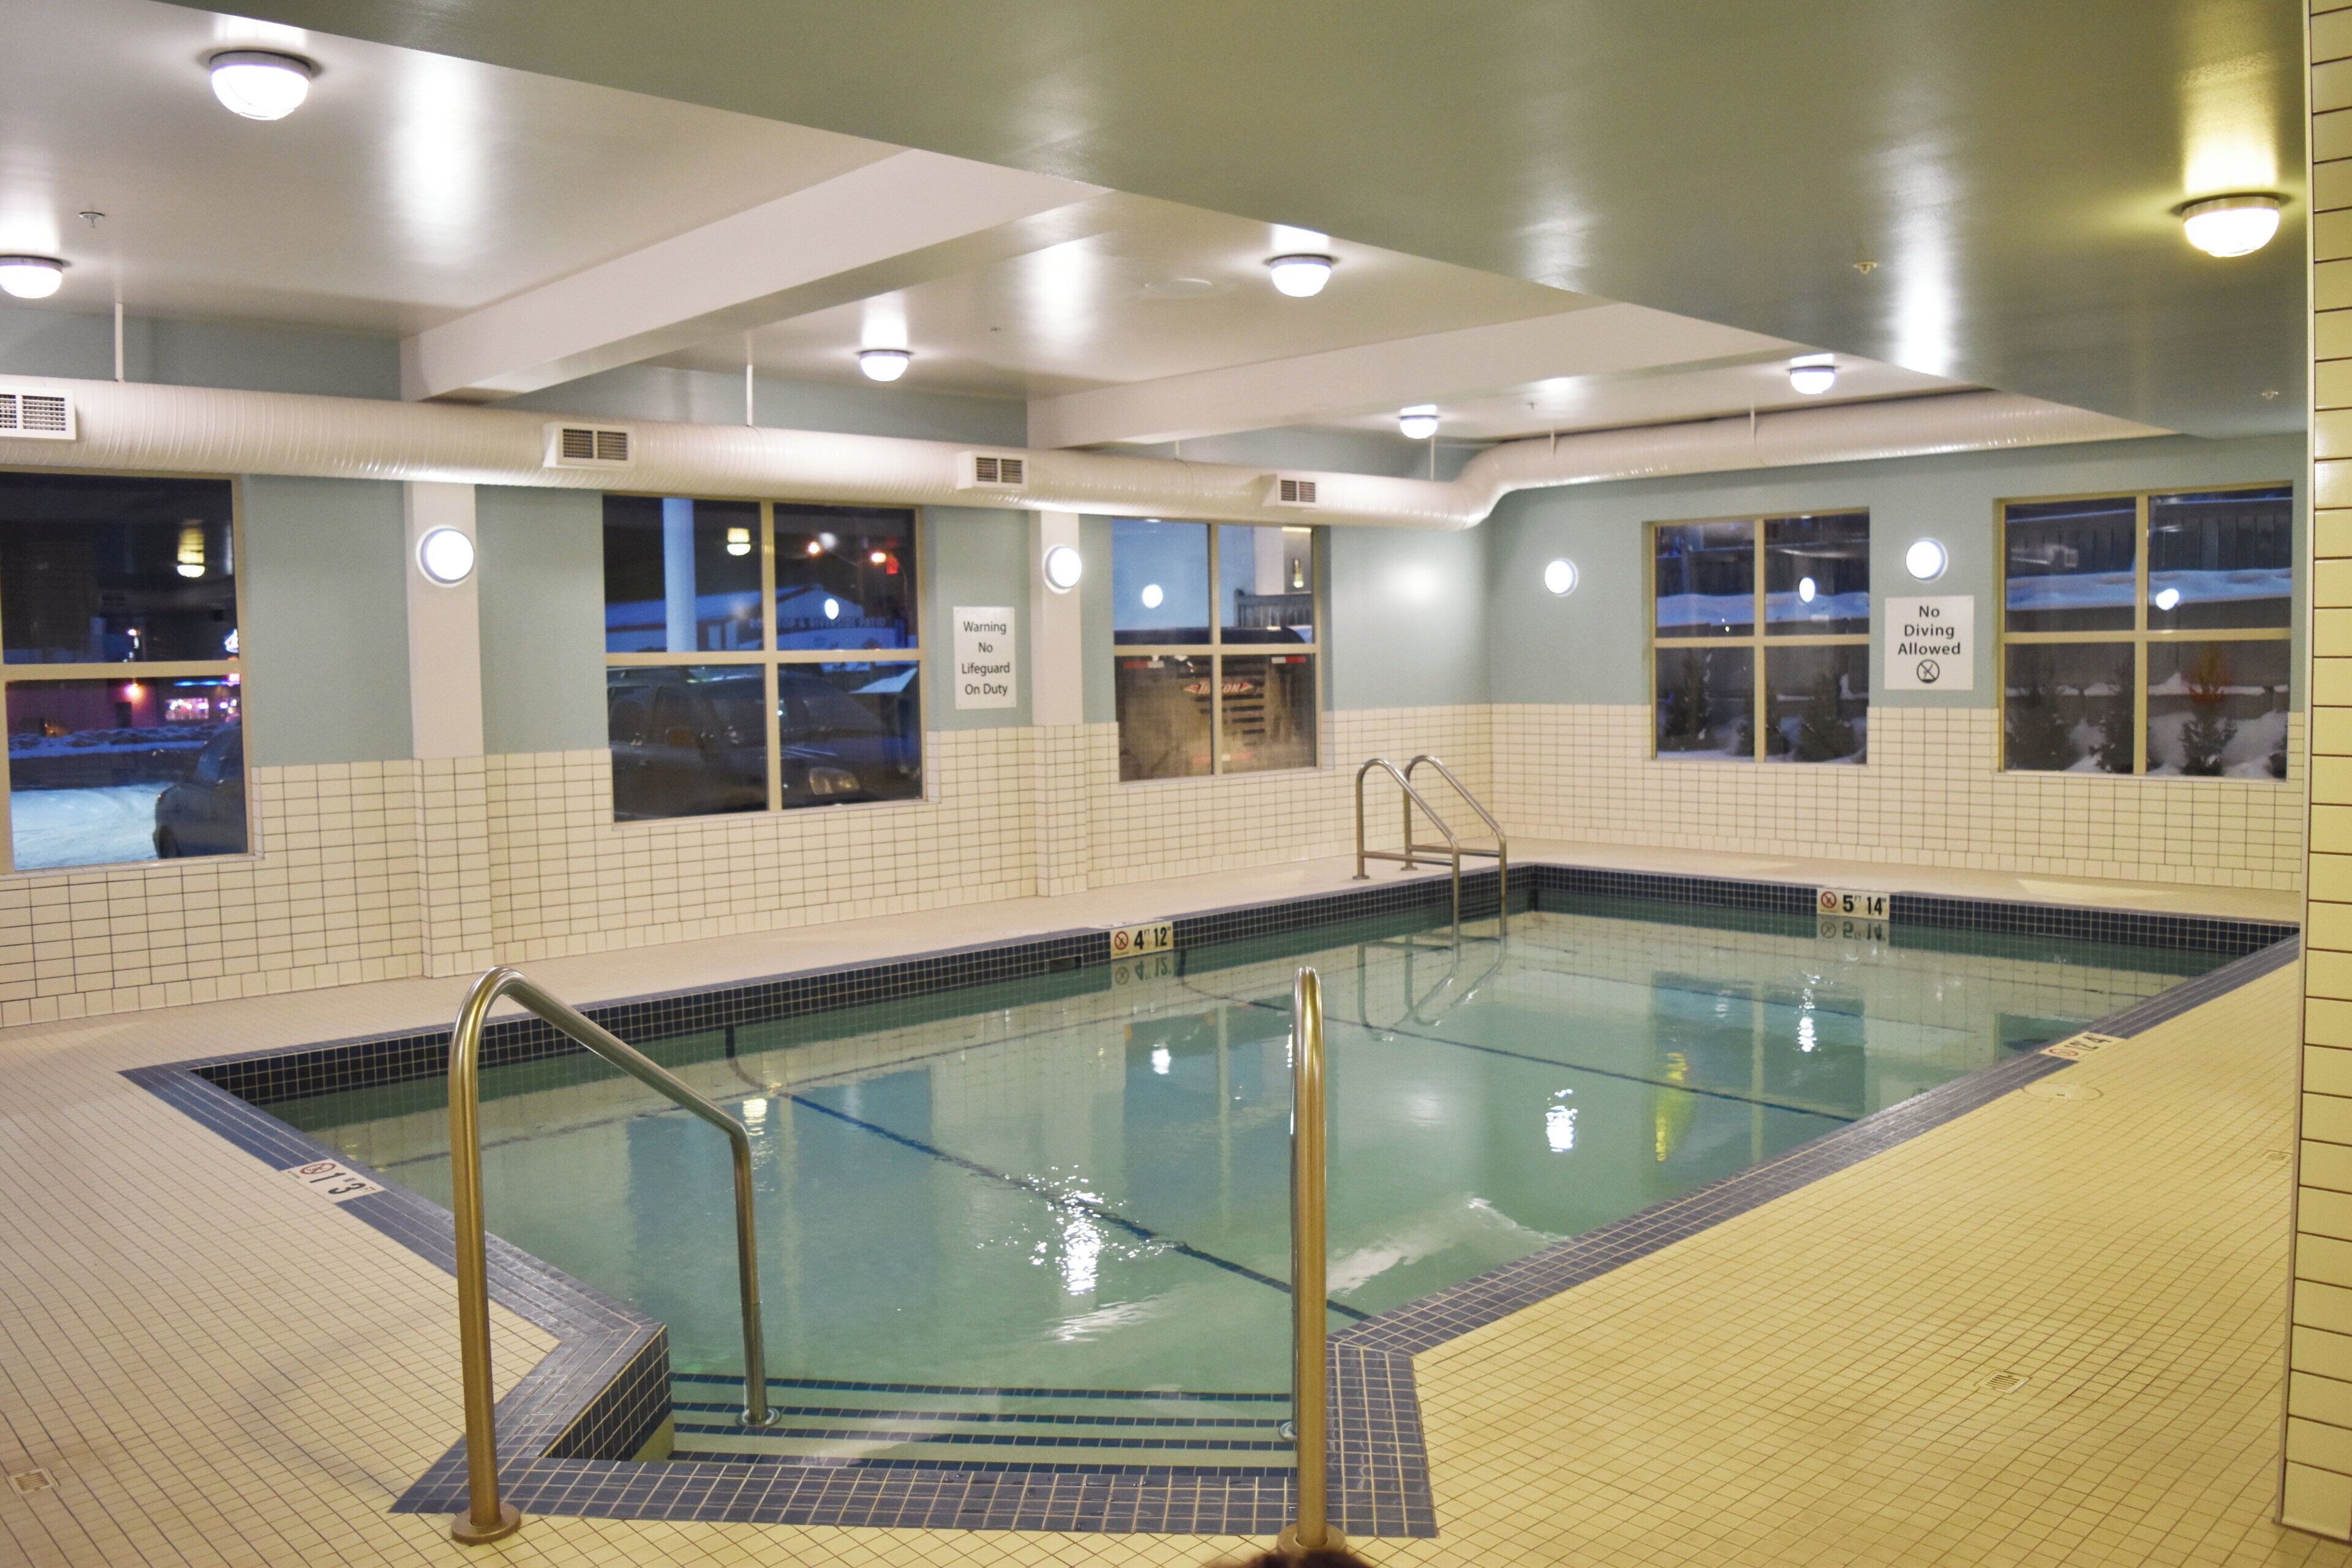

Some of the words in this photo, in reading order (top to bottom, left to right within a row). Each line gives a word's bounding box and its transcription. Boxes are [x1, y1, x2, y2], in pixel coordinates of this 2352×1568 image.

[1919, 605, 1940, 617] No
[963, 621, 1006, 635] Warning
[1904, 624, 1954, 639] Diving
[978, 642, 993, 653] No
[1898, 642, 1961, 655] Allowed
[962, 662, 1010, 676] Lifeguard
[965, 684, 980, 695] On
[984, 684, 1008, 696] Duty
[1843, 895, 1854, 913] 5
[1134, 930, 1144, 950] 4
[328, 1183, 366, 1194] 3
